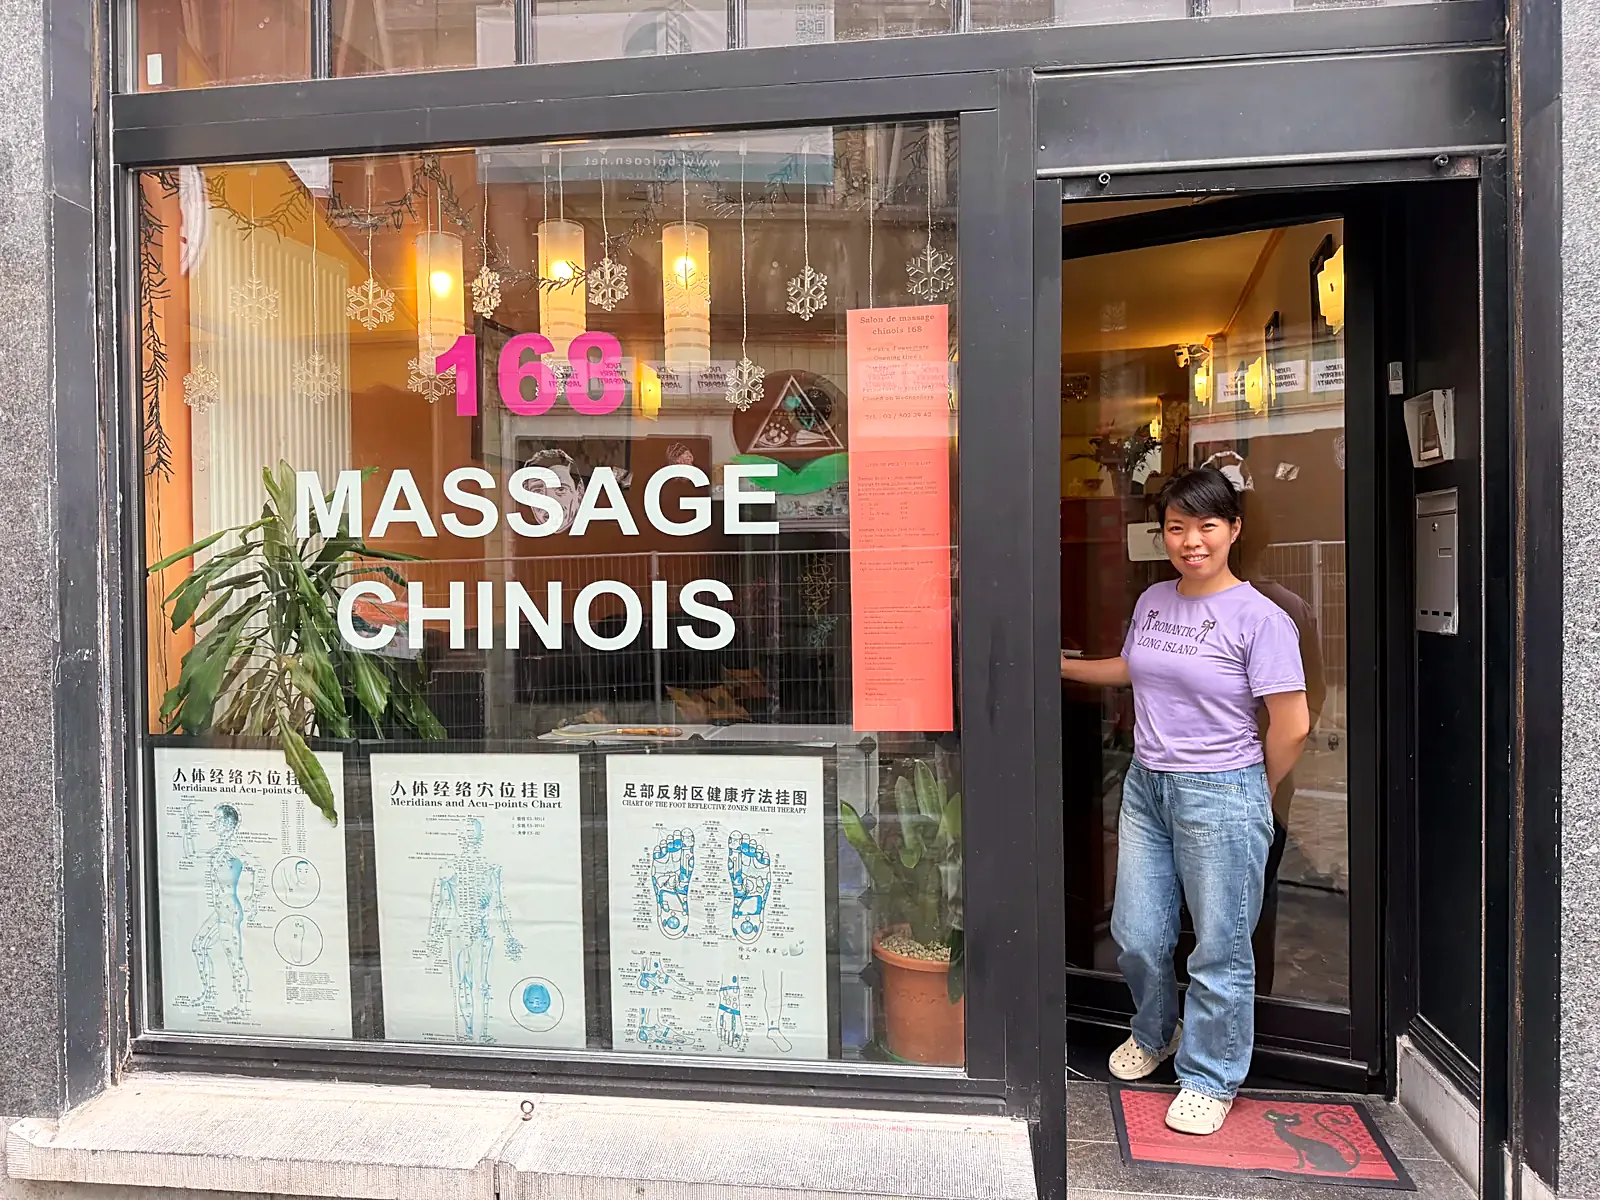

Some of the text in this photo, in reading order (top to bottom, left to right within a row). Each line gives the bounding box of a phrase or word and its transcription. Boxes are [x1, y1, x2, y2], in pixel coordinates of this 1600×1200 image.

[860, 314, 935, 324] Salon de massage
[872, 325, 923, 335] chinois 168
[435, 331, 624, 416] 168
[295, 464, 779, 538] MASSAGE
[336, 580, 735, 651] CHINOIS
[1151, 620, 1197, 638] ROMANTIC
[1137, 635, 1198, 656] LONG ISLAND
[172, 783, 218, 793] Meridians
[219, 785, 236, 793] and
[239, 785, 292, 796] Acu-points
[390, 780, 560, 799] 人体经络穴位挂图
[622, 783, 807, 806] 足部反射区健康疗法挂图
[390, 798, 562, 810] Meridians and Acu-points Chart
[622, 799, 644, 807] CHART
[687, 802, 727, 811] REFLECTIVE
[728, 804, 749, 812] ZONES
[750, 805, 776, 813] HEALTH
[777, 806, 807, 814] THERAPY
